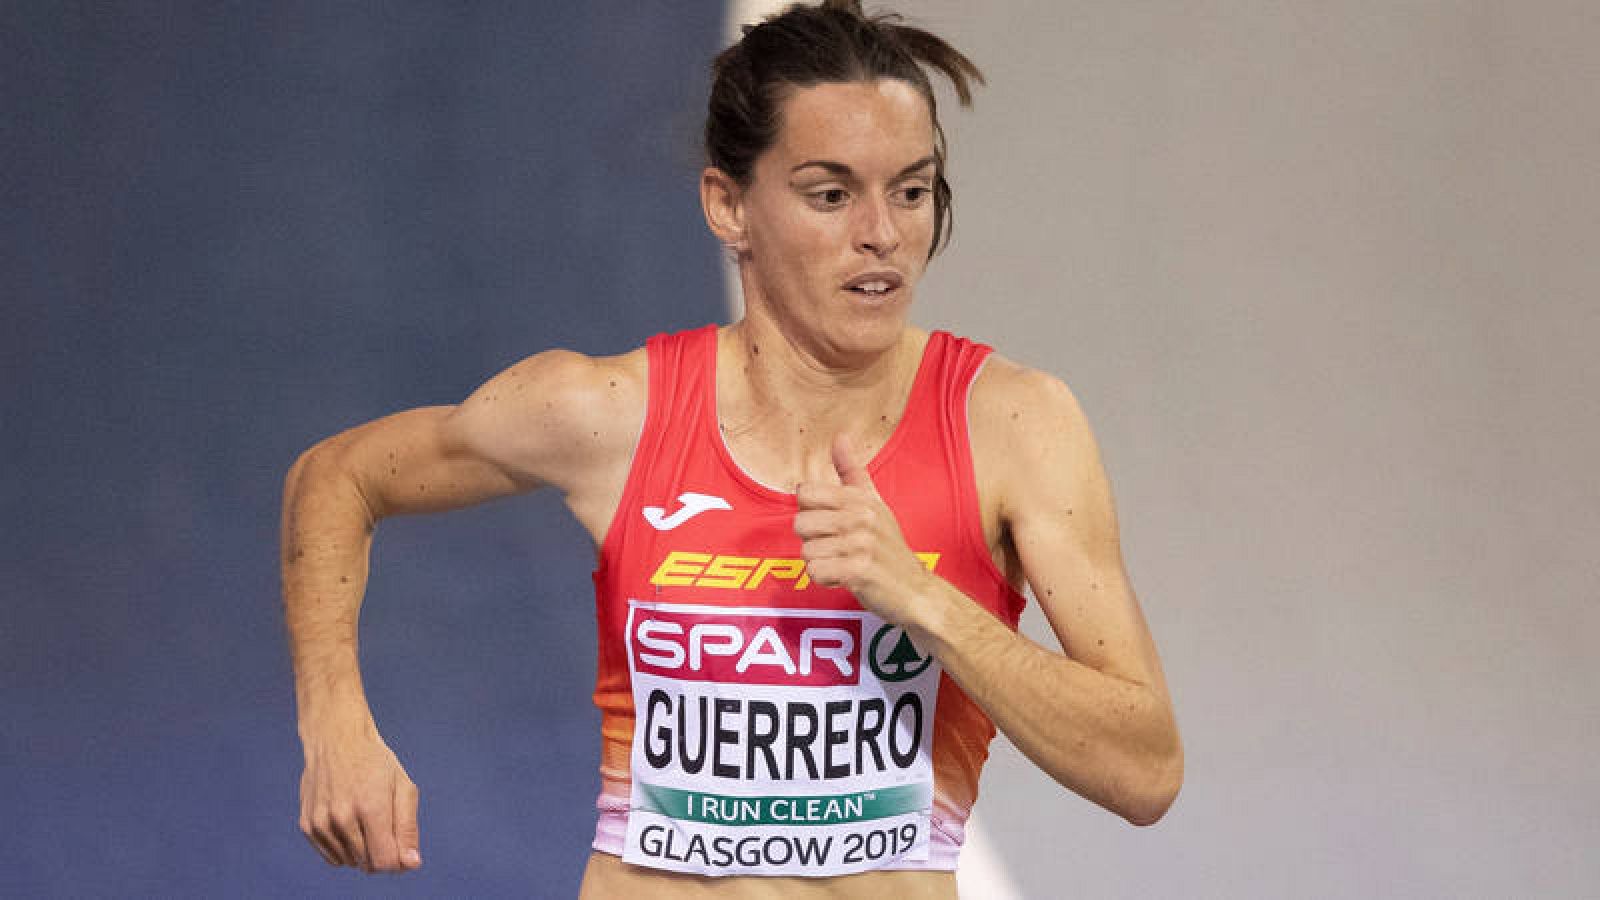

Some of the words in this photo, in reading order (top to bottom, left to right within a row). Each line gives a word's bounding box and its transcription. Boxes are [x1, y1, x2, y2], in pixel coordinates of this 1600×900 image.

[650, 551, 941, 590] ESP
[636, 619, 857, 677] SPAR
[643, 688, 923, 781] GUERRERO
[687, 794, 693, 817] I
[701, 797, 761, 821] RUN
[639, 825, 833, 868] GLASGOW
[842, 823, 918, 863] 2019
